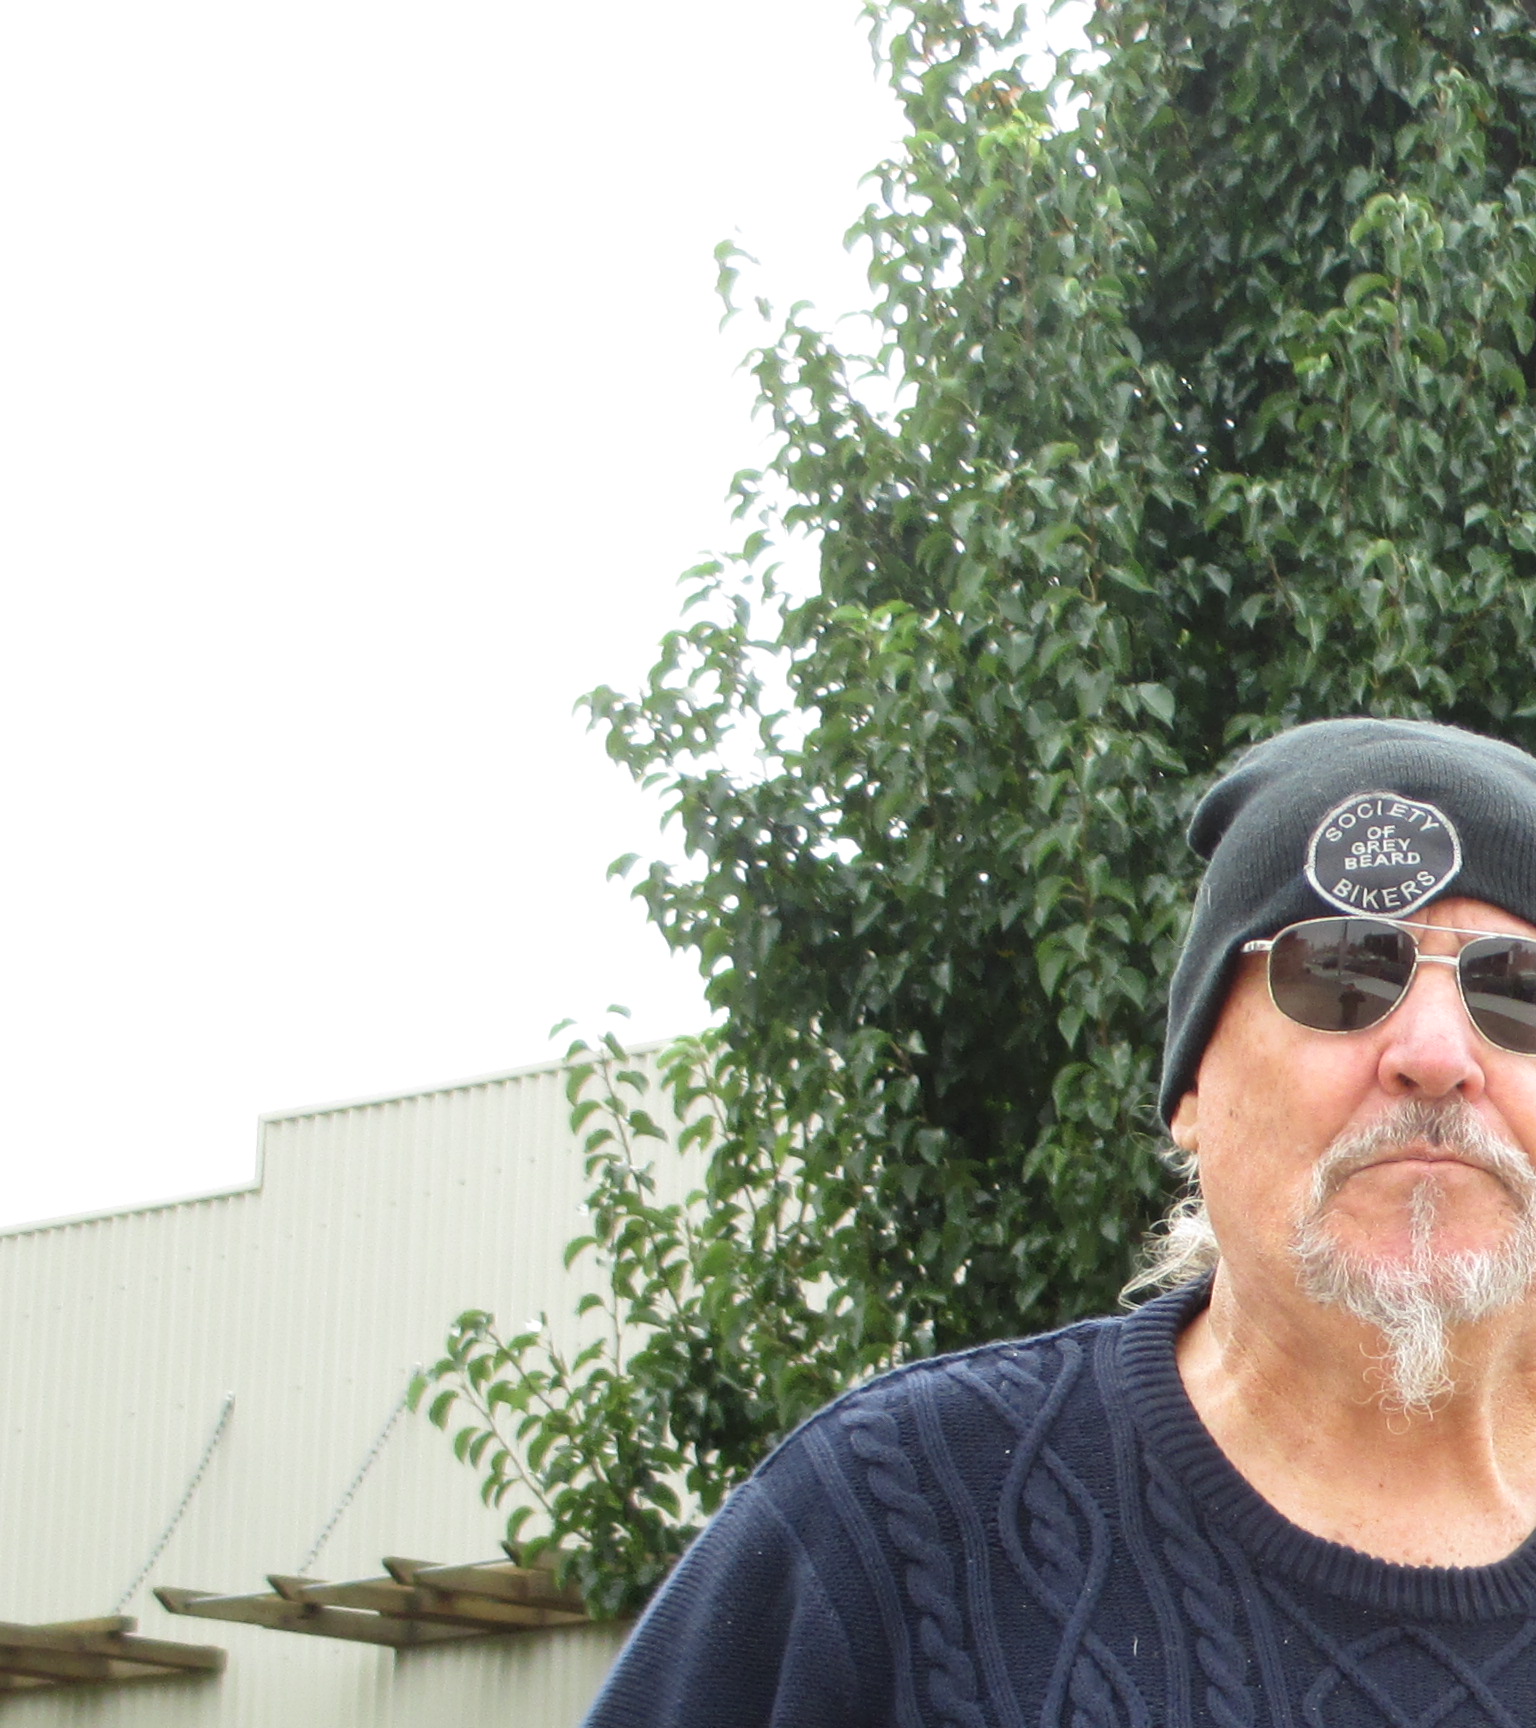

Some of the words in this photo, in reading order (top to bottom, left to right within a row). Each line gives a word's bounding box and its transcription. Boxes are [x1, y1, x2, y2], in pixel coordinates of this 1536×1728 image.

[1325, 800, 1440, 842] SOCIETY
[1367, 825, 1396, 840] OF
[1352, 838, 1411, 855] GREY
[1344, 852, 1421, 870] BEARD
[1333, 871, 1436, 909] BIKERS
